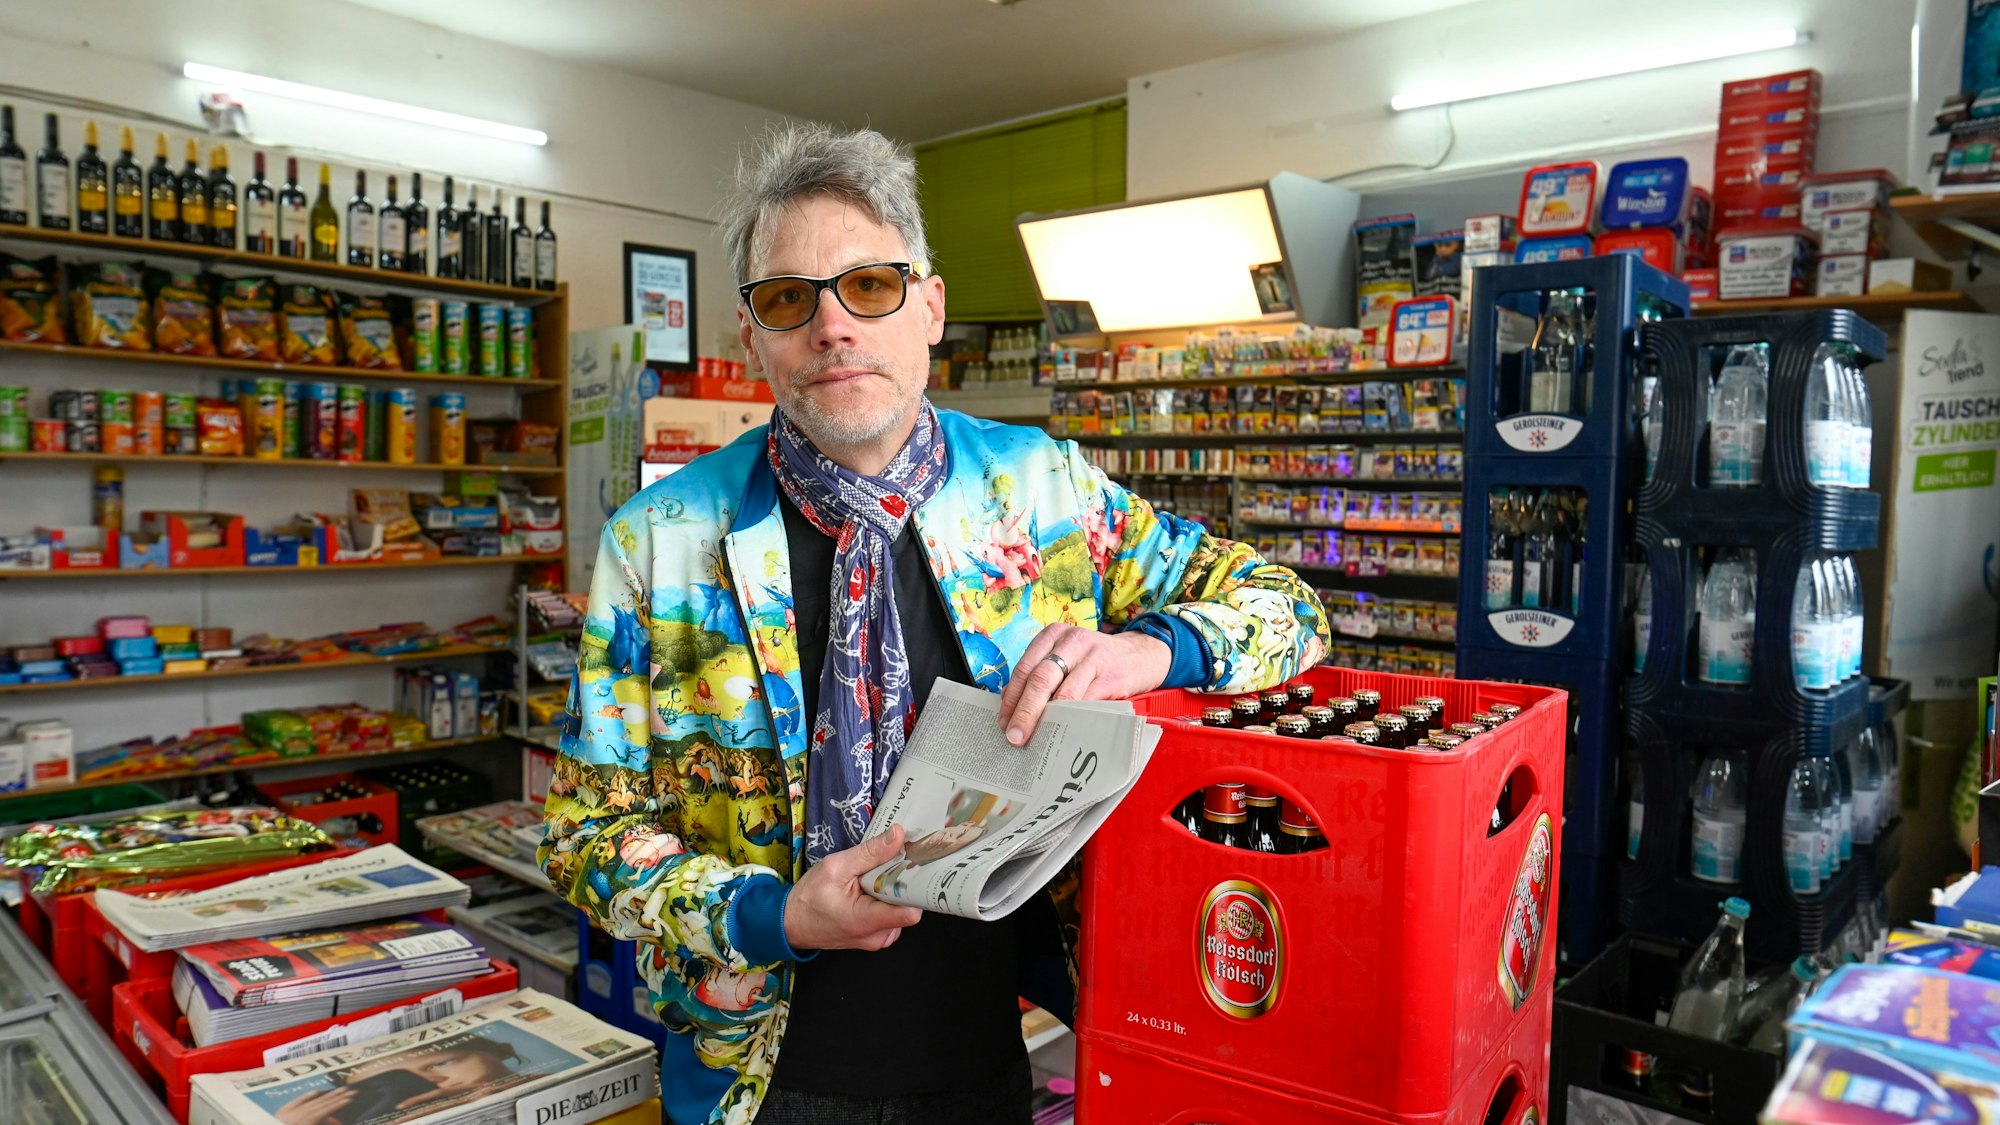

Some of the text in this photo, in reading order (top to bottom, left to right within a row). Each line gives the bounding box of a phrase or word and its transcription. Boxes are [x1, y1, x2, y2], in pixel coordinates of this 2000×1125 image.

[1617, 196, 1667, 212] Winston
[1513, 417, 1566, 431] GEROLSTEINER
[1505, 614, 1557, 627] GEROLSTEINER
[1206, 934, 1275, 967] Reissdorf
[1214, 960, 1265, 990] Kölsch
[1126, 1011, 1187, 1036] 24 x 0,33 ltr.
[284, 1010, 490, 1078] DIE ZEIT
[265, 1024, 498, 1098] Social Media verbieten?
[535, 1097, 572, 1125] DIE
[597, 1073, 642, 1103] ZEIT
